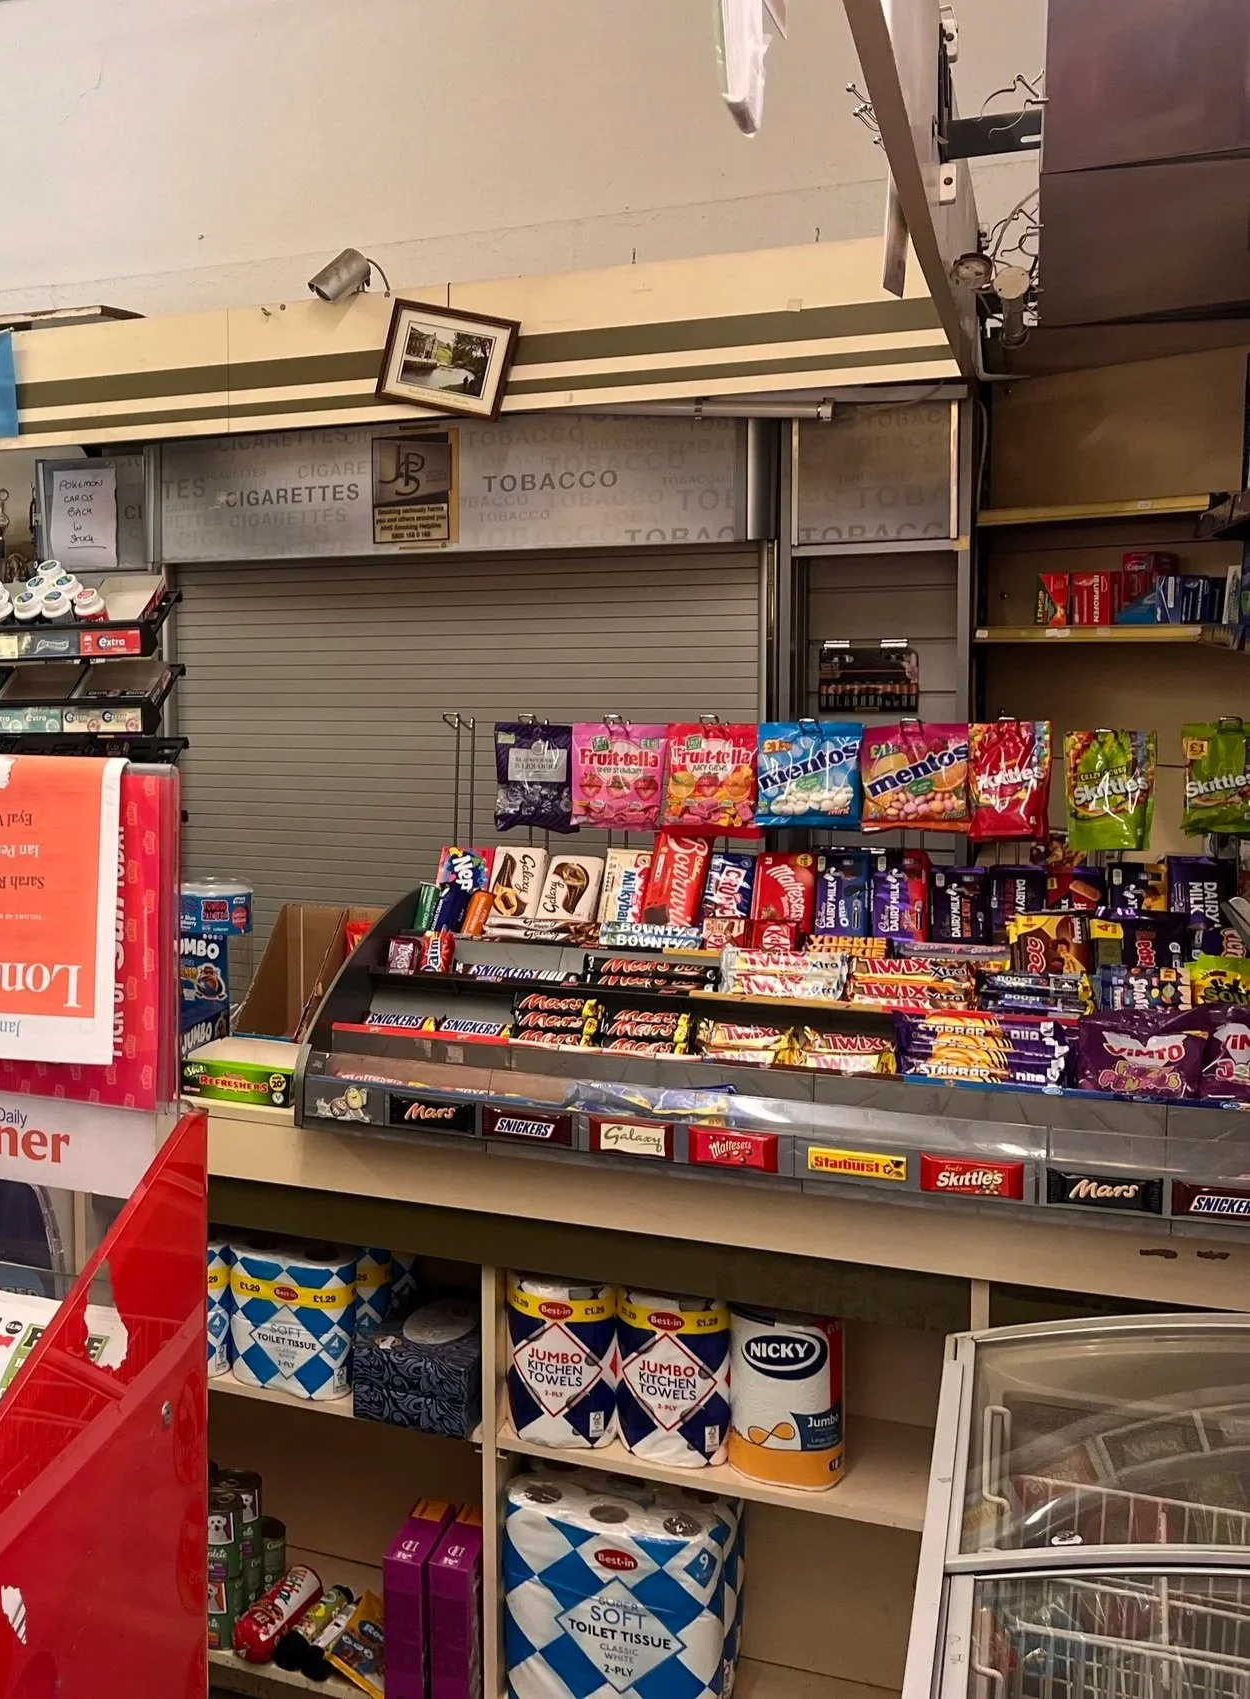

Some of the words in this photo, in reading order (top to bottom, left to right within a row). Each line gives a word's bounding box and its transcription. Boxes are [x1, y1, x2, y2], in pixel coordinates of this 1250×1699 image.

[59, 480, 103, 491] POKEMON
[482, 469, 618, 493] TOBACCO
[225, 483, 360, 508] CIGARETTES
[757, 744, 860, 791] mentos
[867, 744, 969, 798] mentos
[7, 813, 33, 826] Eyal
[19, 844, 39, 858] Ian
[514, 853, 536, 895] Galaxy
[616, 870, 637, 921] Milkybar
[1189, 881, 1204, 913] MILK
[1203, 881, 1219, 927] DAIRY
[616, 934, 683, 949] BOUNTY
[865, 958, 931, 975] TWIX
[930, 966, 966, 978] Xtra
[518, 993, 585, 1011] Mars
[368, 1013, 420, 1027] SNICKERS
[444, 1020, 500, 1035] SNICKERS
[404, 1102, 456, 1124] Mars
[494, 1116, 555, 1138] SNICKERS
[603, 1123, 664, 1153] Galaxy
[708, 1138, 752, 1160] Maltesers
[813, 1155, 881, 1174] Starburst
[935, 1170, 1004, 1188] Skittles
[1068, 1178, 1140, 1200] Mars
[239, 1282, 261, 1293] £1.29
[313, 1295, 337, 1303] £1.29
[541, 1305, 571, 1316] Best-in
[584, 1306, 606, 1315] £1.29
[650, 1316, 682, 1327] Best-in
[696, 1317, 719, 1327] £1.29
[257, 1332, 287, 1346] TOILET
[288, 1339, 317, 1351] TISSUE
[750, 1342, 809, 1358] NICKY
[528, 1347, 583, 1364] JUMBO
[527, 1358, 583, 1376] KITCHEN
[639, 1360, 696, 1378] JUMBO
[528, 1369, 583, 1387] TOWELS
[638, 1371, 697, 1389] KITCHEN
[639, 1383, 697, 1401] TOWELS
[807, 1413, 839, 1429] Jumbo
[597, 1552, 635, 1568] Best-in
[699, 1553, 709, 1571] 9
[590, 1605, 648, 1630] SOFT
[568, 1618, 617, 1641] TOILET
[621, 1631, 673, 1650] TISSUE
[599, 1642, 639, 1657] CLASSIC
[604, 1651, 635, 1664] WHITE
[603, 1663, 634, 1678] 2-PLY
